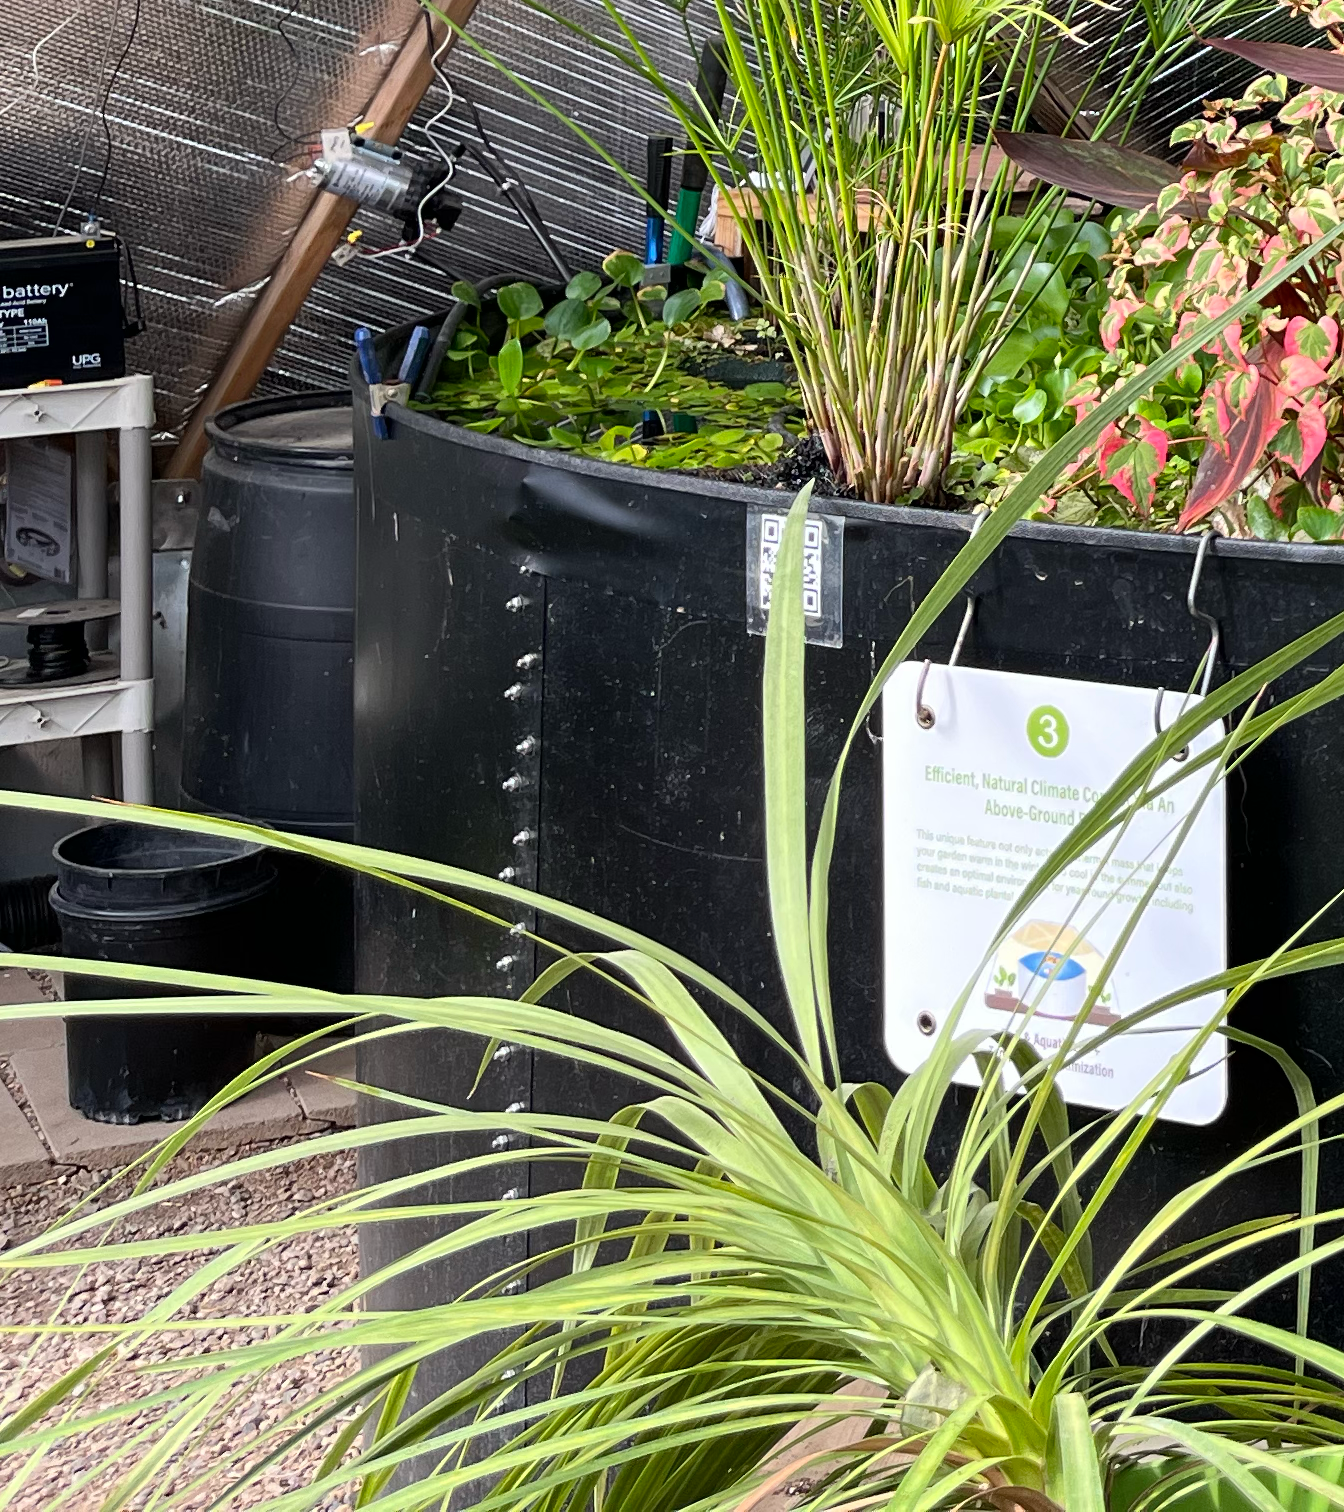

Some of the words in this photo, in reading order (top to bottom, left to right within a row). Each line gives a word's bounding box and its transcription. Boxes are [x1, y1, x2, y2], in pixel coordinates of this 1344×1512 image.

[72, 353, 101, 366] UPG
[1038, 714, 1058, 749] 3
[925, 765, 979, 790] Efficient,
[982, 772, 1027, 794] Natural
[1031, 779, 1080, 801] Climate
[1158, 796, 1175, 814] An
[984, 798, 1075, 826] Above-Ground
[916, 828, 934, 841] This
[936, 832, 965, 845] unique
[967, 835, 996, 849] feature
[1015, 843, 1033, 857] only
[1111, 858, 1136, 869] mass
[916, 847, 935, 857] your
[937, 849, 967, 861] garden
[969, 855, 993, 865] warm
[1069, 869, 1087, 879] cool
[917, 876, 932, 889] fish
[934, 881, 950, 892] and
[952, 884, 983, 897] aquatic
[917, 862, 947, 875] creates
[962, 869, 994, 882] optimal
[1152, 897, 1194, 915] including
[1034, 1034, 1066, 1050] Aquat
